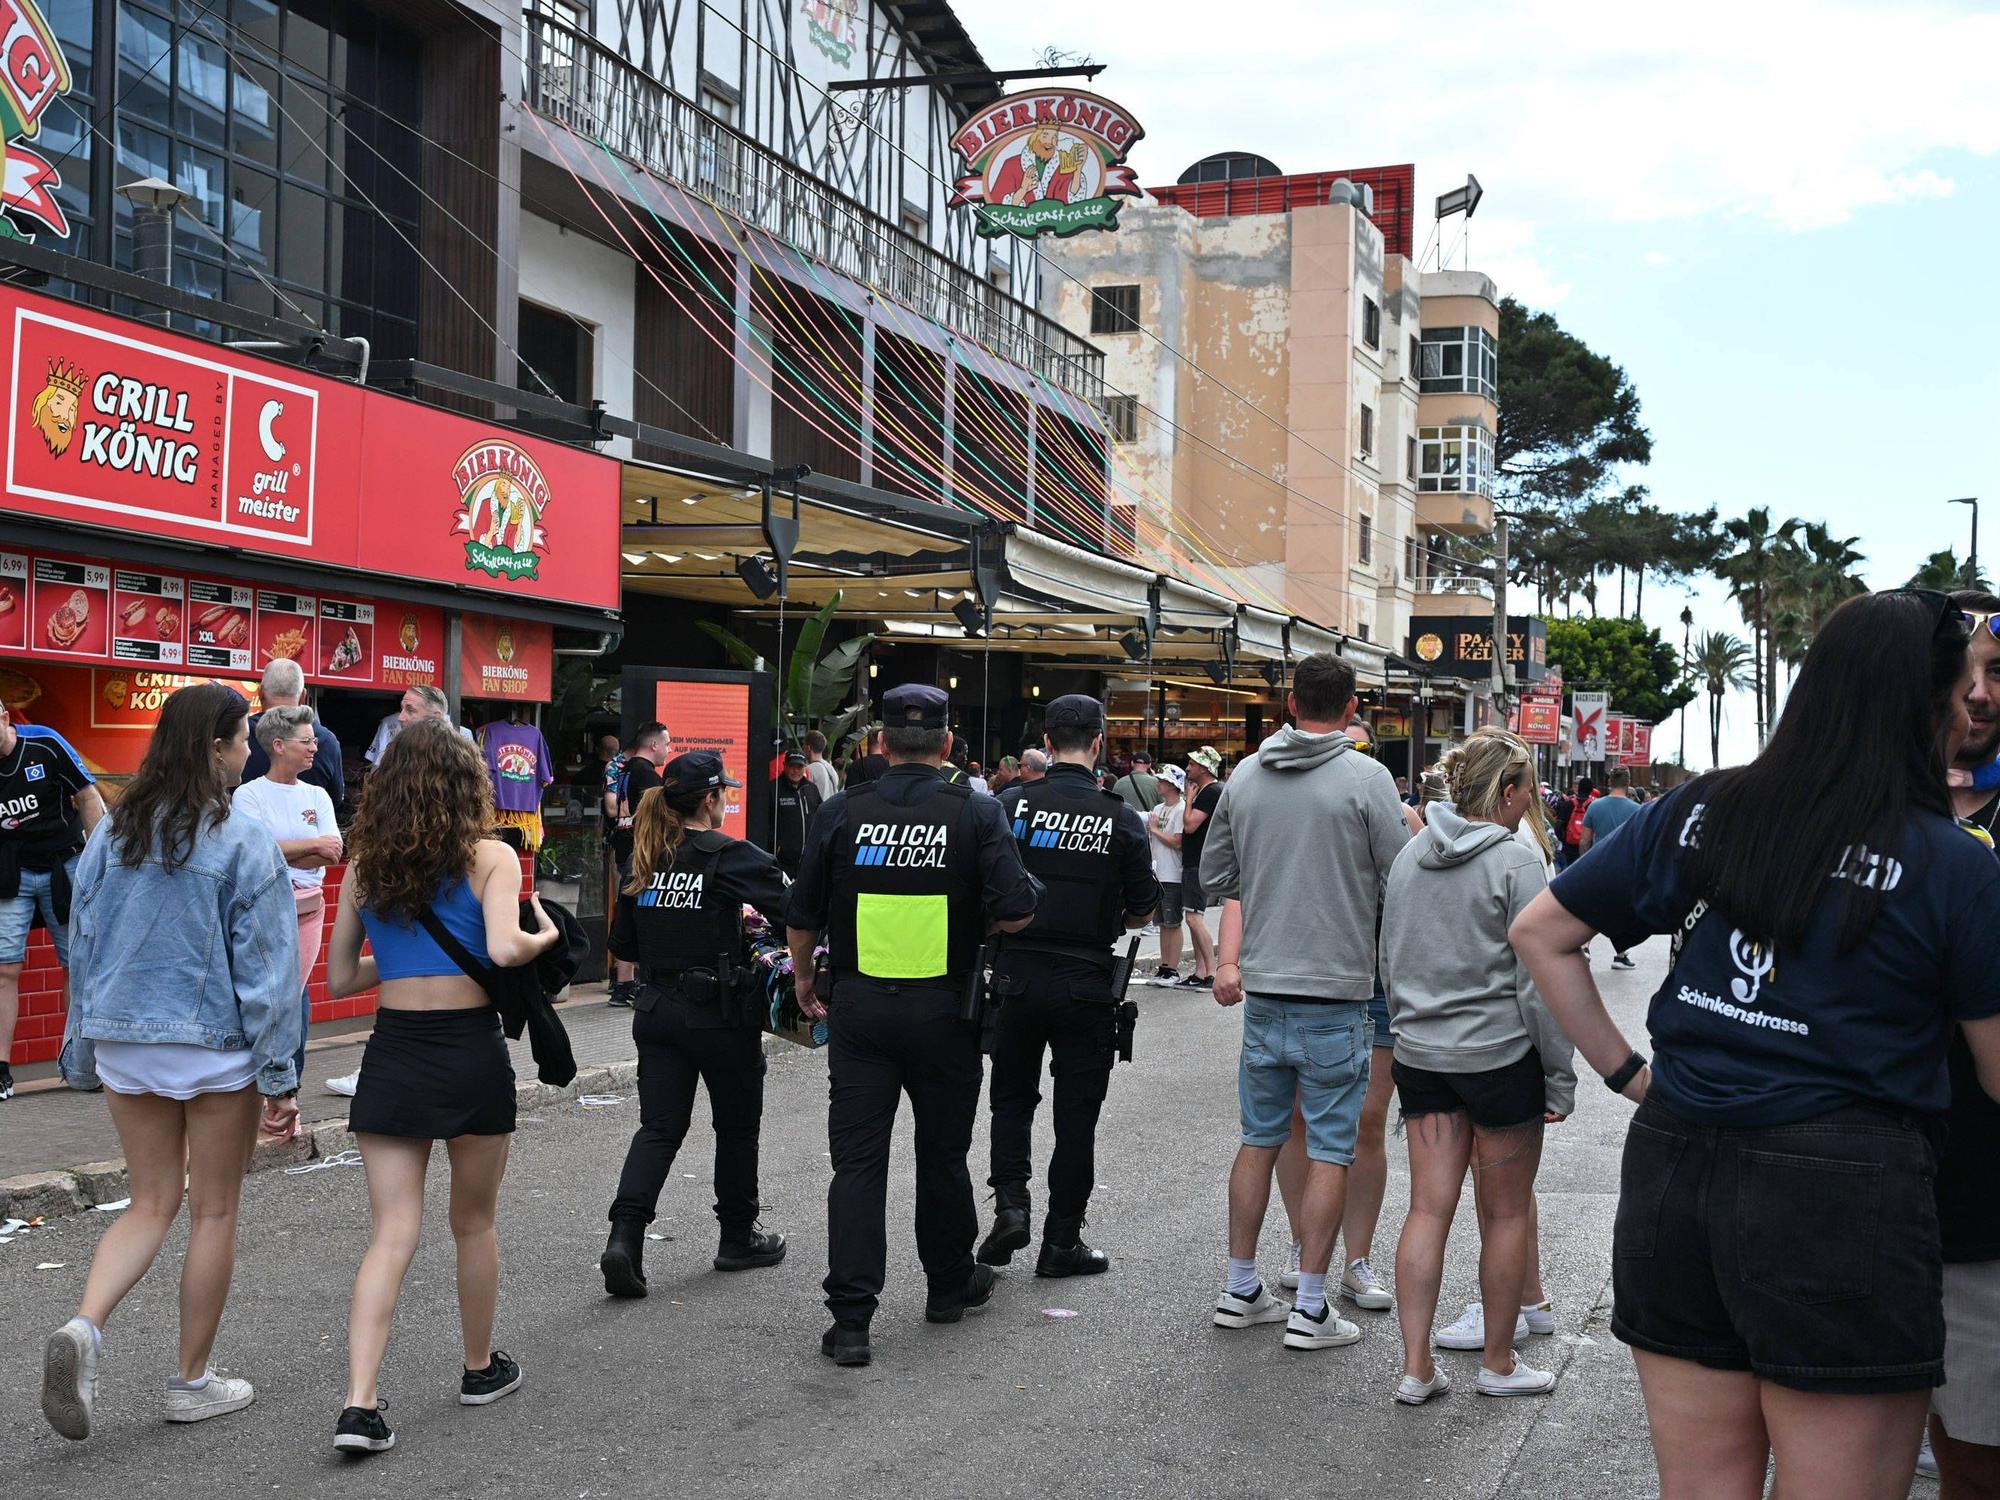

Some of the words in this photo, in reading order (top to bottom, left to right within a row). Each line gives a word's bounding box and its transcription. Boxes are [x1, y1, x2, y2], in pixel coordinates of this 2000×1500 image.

[958, 96, 1130, 157] BIERKÖNIG
[990, 204, 1104, 228] Schinkenstrasse
[93, 371, 195, 434] GRILL
[215, 381, 225, 404] BY
[81, 422, 199, 484] KÖNIG
[210, 416, 222, 509] MANAGED
[252, 470, 289, 494] grill
[456, 448, 546, 507] BIERKÖNIG
[238, 495, 300, 522] meister
[472, 548, 533, 570] Schinkenstrasse
[198, 630, 216, 643] XXL
[382, 655, 435, 674] BIERKÖNIG
[1458, 647, 1526, 661] KELER
[382, 669, 404, 685] FAN
[406, 672, 435, 687] SHOP
[482, 664, 528, 680] BIERKÖNIG
[482, 678, 500, 692] FAN
[502, 680, 528, 694] SHOP
[1529, 707, 1551, 715] GRILL
[855, 823, 948, 846] POLICIA
[1031, 810, 1113, 836] POLICIA
[1058, 832, 1111, 855] LOCAL
[885, 845, 946, 868] LOCAL
[655, 890, 703, 909] LOCAL
[1677, 984, 1809, 1037] Schinkenstrasse
